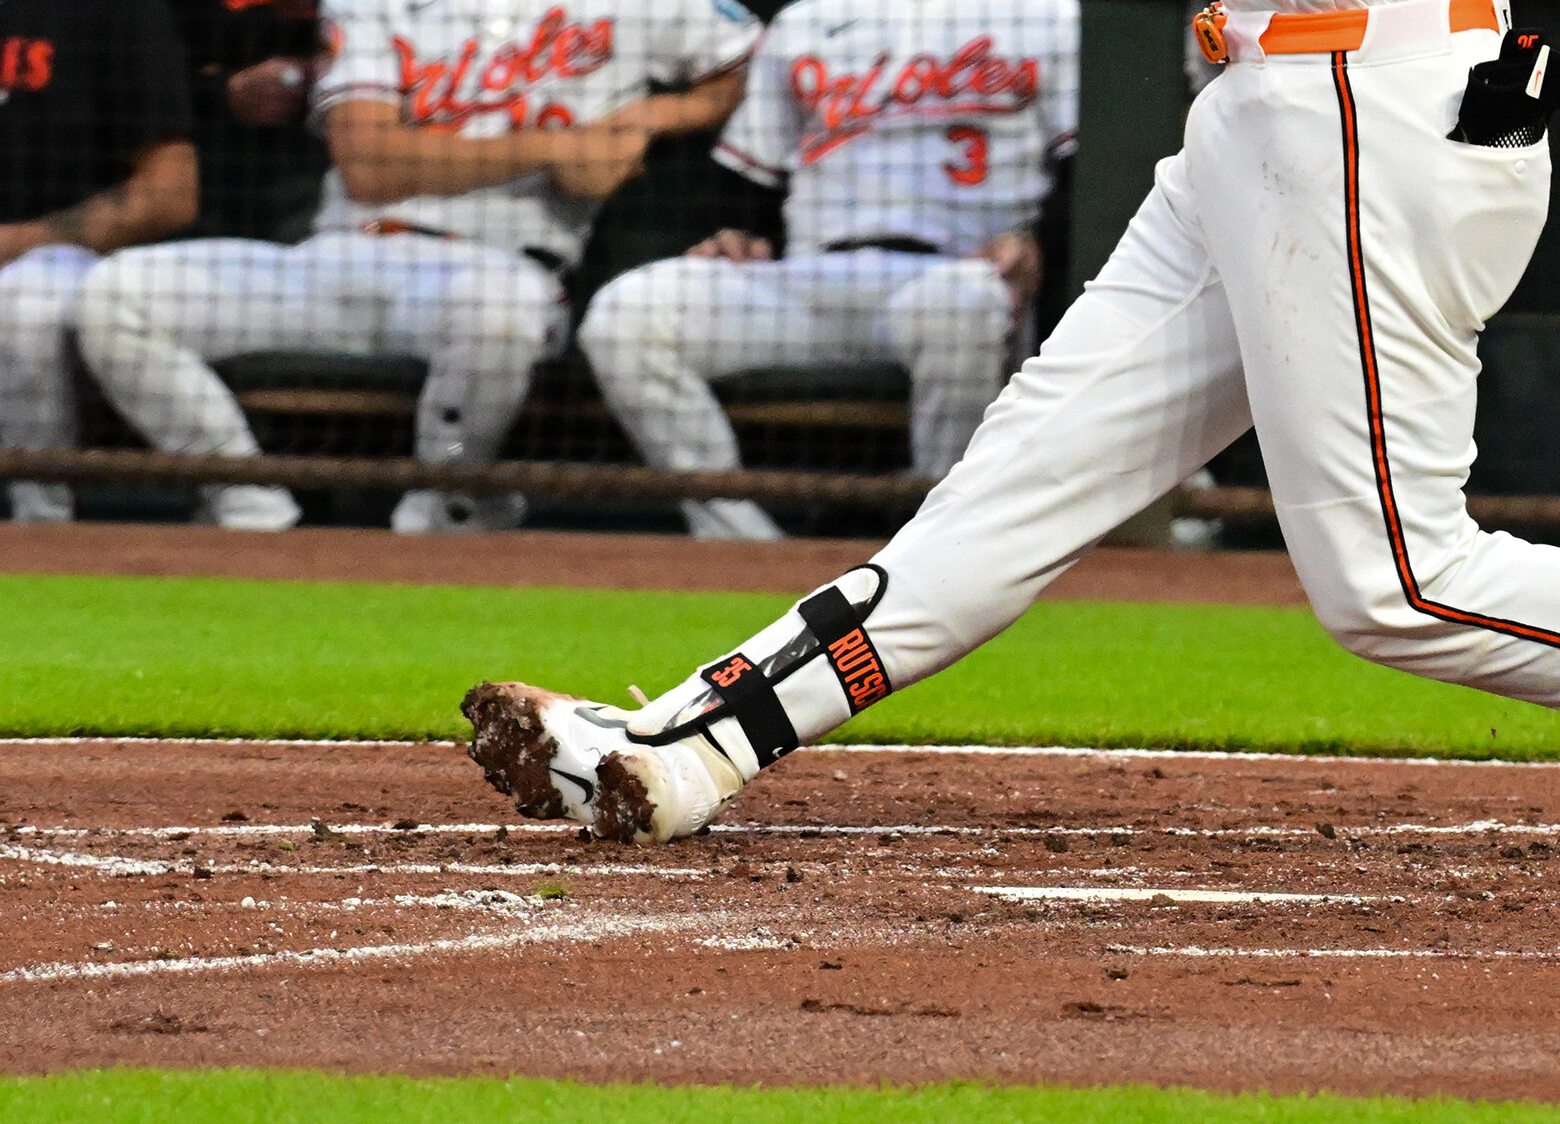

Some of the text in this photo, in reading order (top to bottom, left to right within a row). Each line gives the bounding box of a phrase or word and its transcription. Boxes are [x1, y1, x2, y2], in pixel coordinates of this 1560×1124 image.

[945, 125, 989, 186] 3
[711, 657, 752, 688] 35
[827, 628, 888, 714] RUTSC
